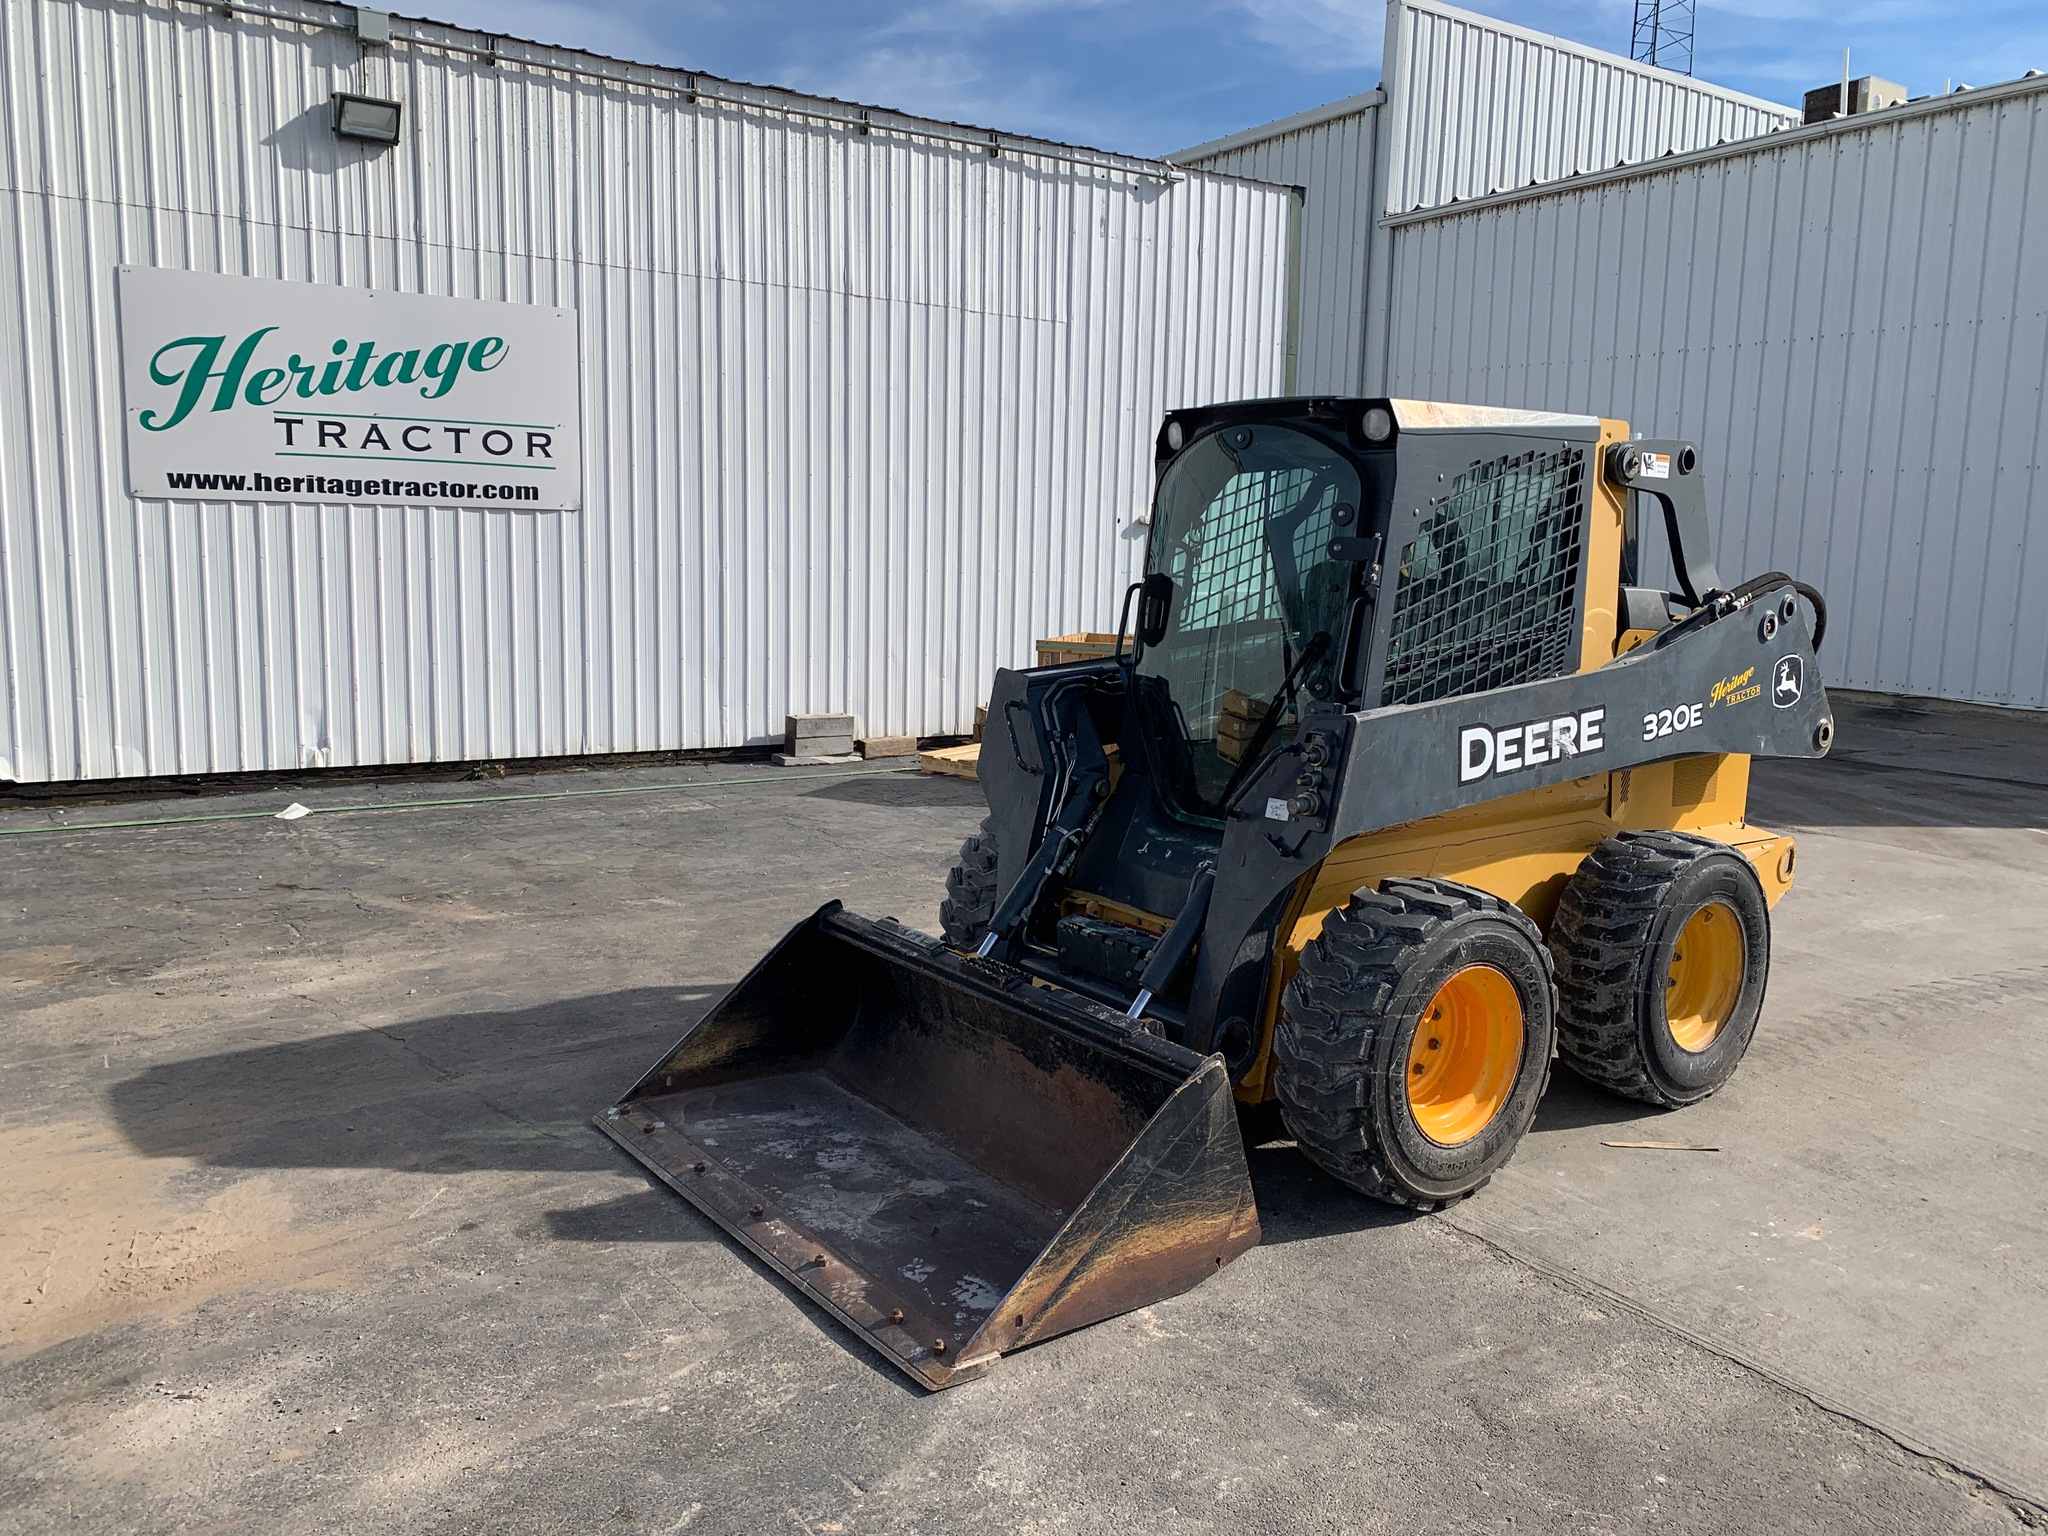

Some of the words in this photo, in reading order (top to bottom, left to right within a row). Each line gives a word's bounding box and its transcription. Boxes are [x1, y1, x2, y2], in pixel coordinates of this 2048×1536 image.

[139, 326, 510, 431] Heritage
[273, 416, 554, 459] TRACTOR
[166, 471, 539, 501] www.heritagetractor.com
[1709, 666, 1755, 708] Heritage
[1725, 685, 1761, 705] TRACTOR
[1643, 702, 1704, 742] 320E
[1459, 708, 1605, 783] DEERE
